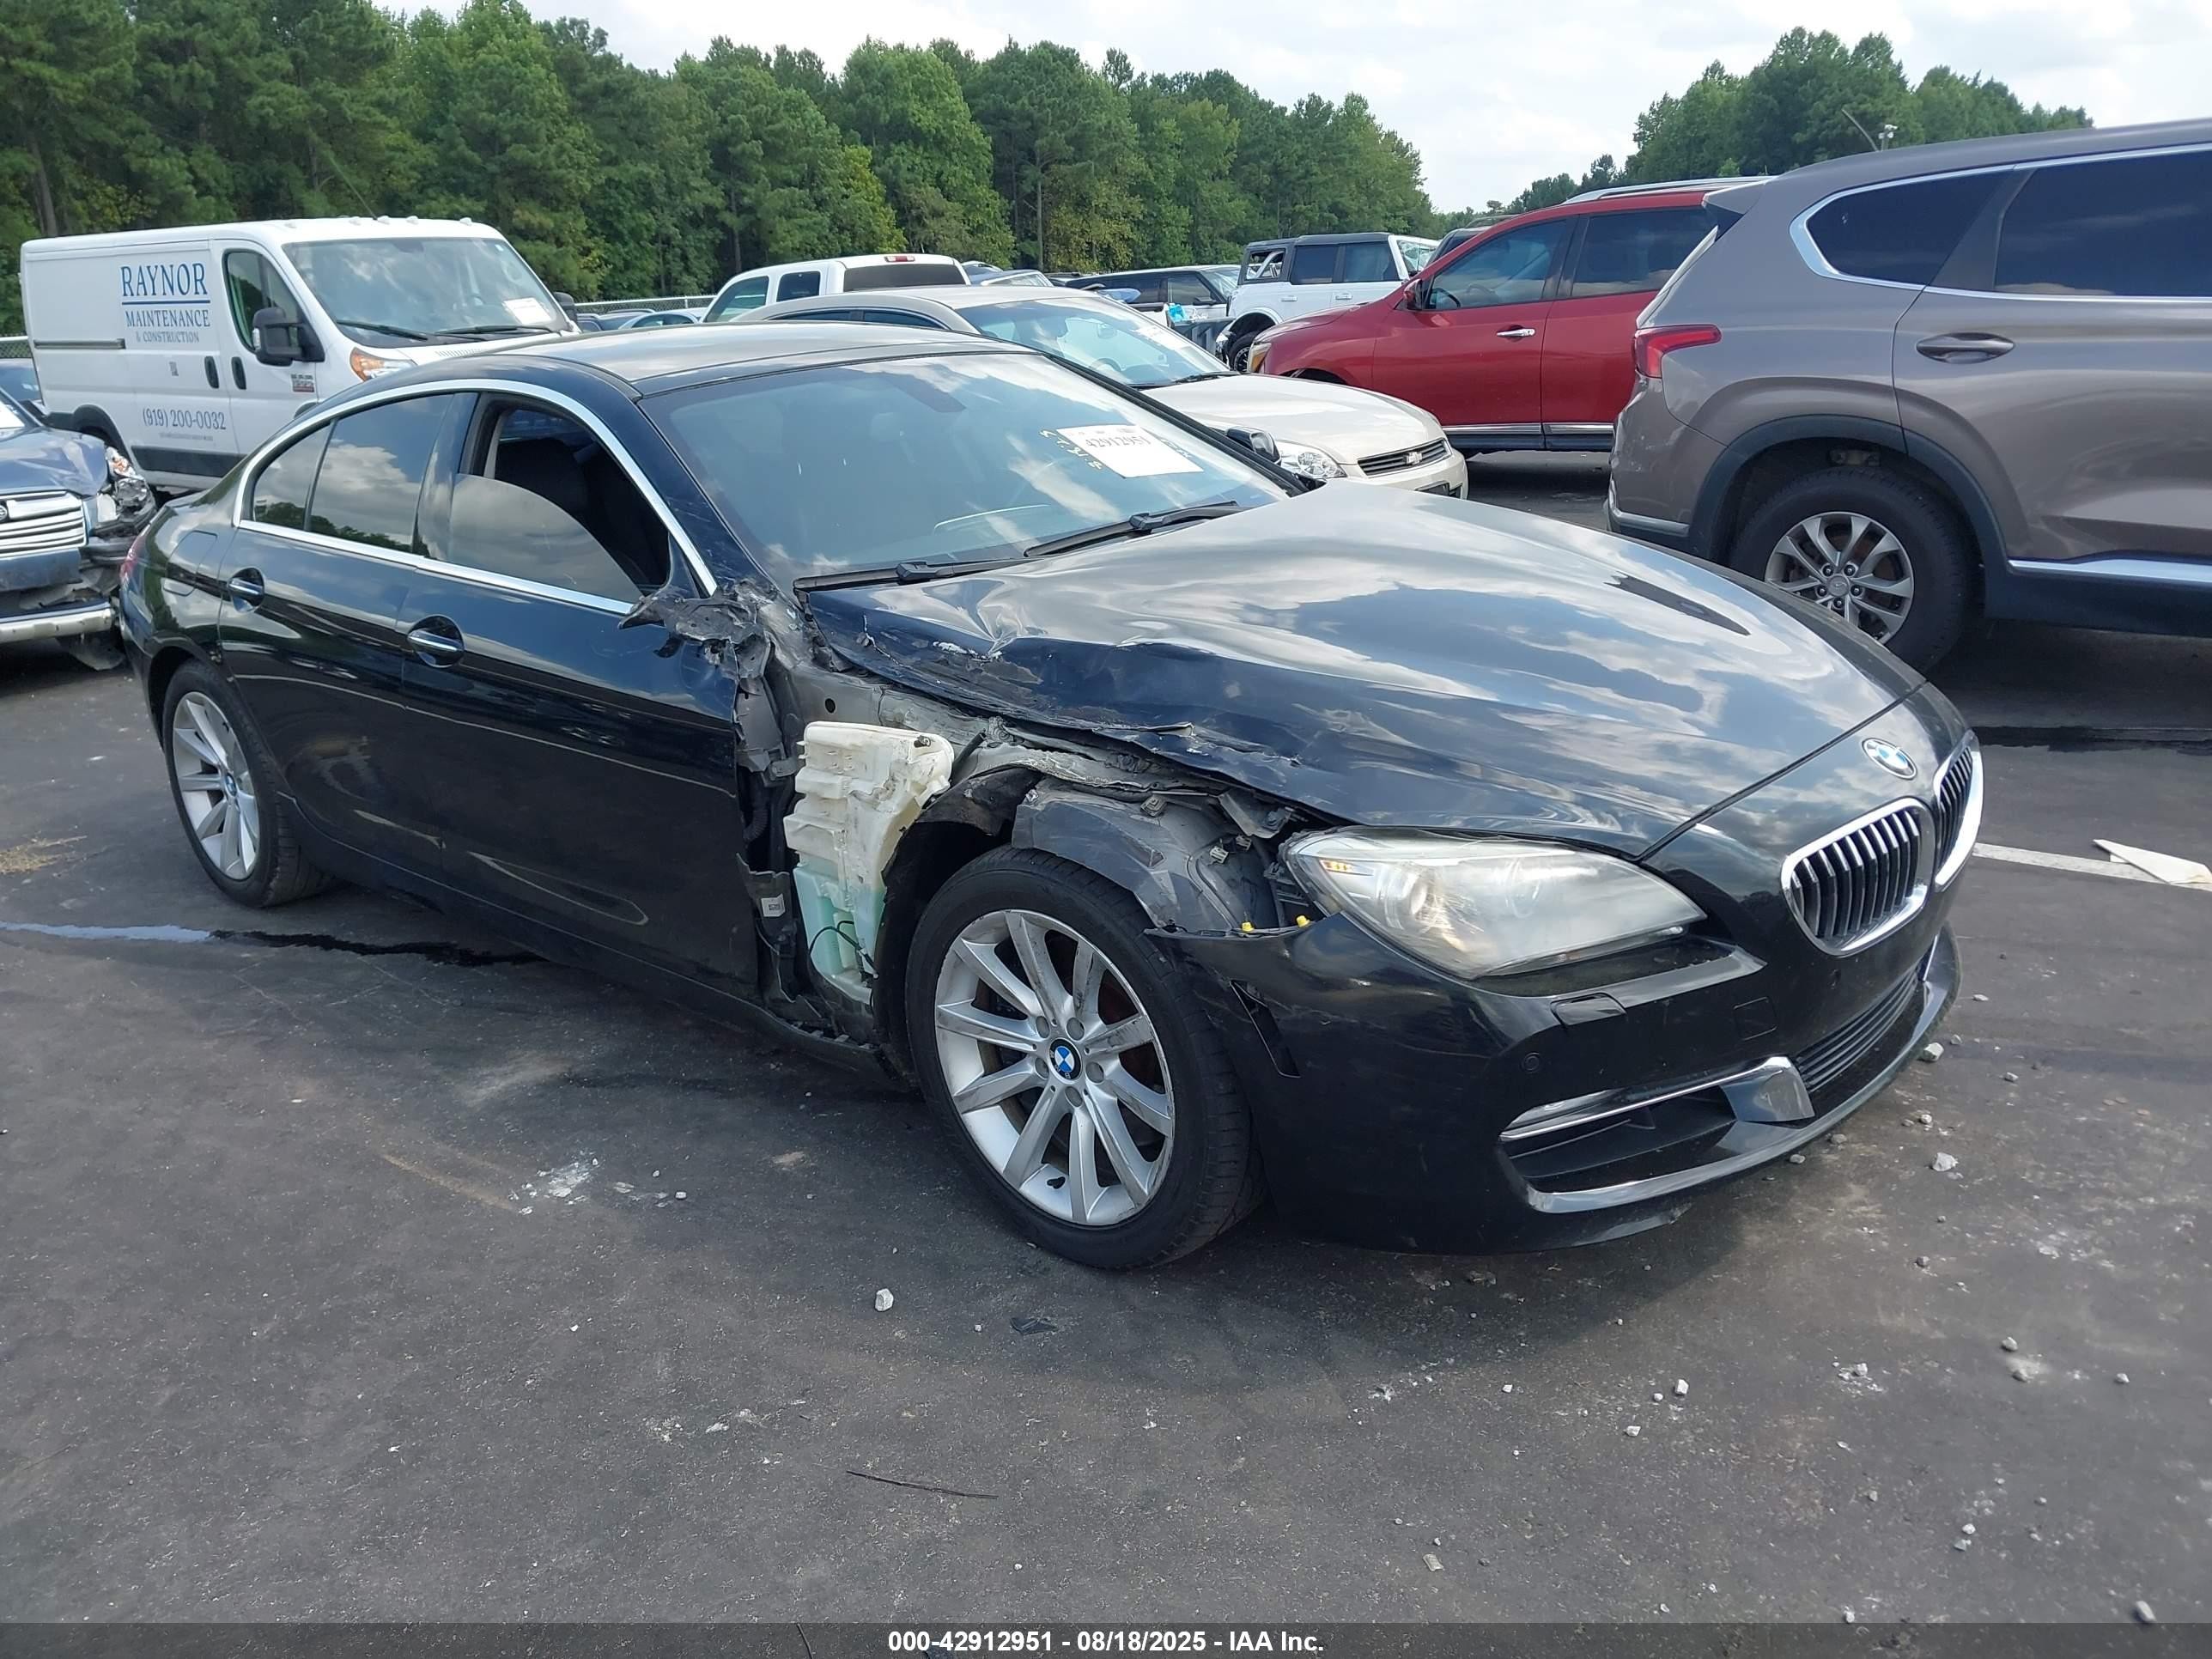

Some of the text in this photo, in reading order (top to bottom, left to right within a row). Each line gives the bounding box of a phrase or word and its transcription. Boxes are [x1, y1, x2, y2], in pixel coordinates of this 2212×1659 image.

[120, 263, 208, 296] RAYNOR
[125, 309, 211, 327] MAINTENANCE
[143, 331, 200, 343] CONSTRUCTION
[143, 408, 227, 430] (919) 200-0032
